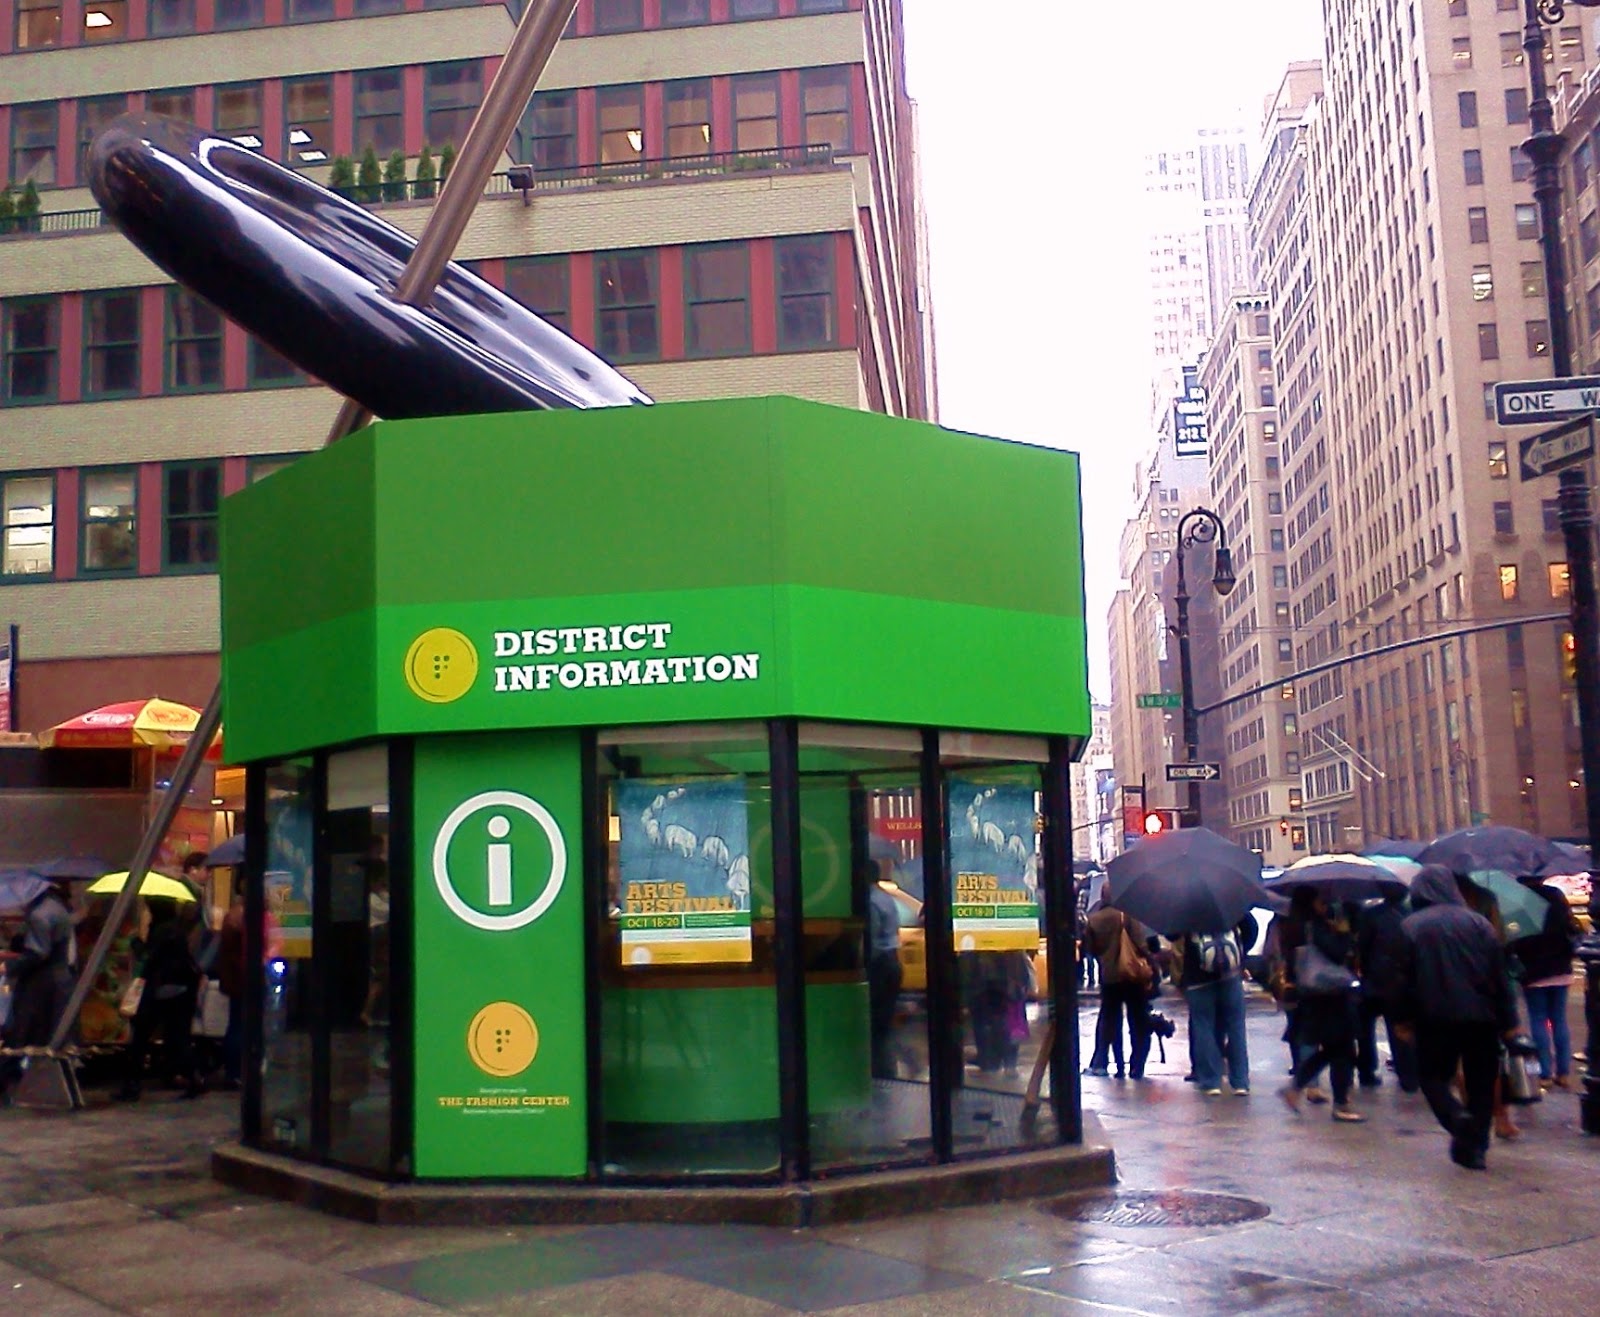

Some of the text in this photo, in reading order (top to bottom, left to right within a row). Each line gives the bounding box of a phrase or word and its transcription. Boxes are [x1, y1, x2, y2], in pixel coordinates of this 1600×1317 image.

[1509, 390, 1600, 412] ONE W
[1530, 430, 1587, 465] ONE WAY
[494, 623, 671, 657] DISTRICT
[494, 653, 759, 692] INFORMATION
[626, 882, 687, 900] ARTS
[957, 875, 998, 890] ARTS
[626, 896, 737, 914] FESTIVAL
[957, 889, 1029, 904] FESTIVAL
[957, 907, 972, 917] OCT
[627, 918, 648, 928] OCT
[439, 1096, 570, 1106] THE FASHION CENTER
